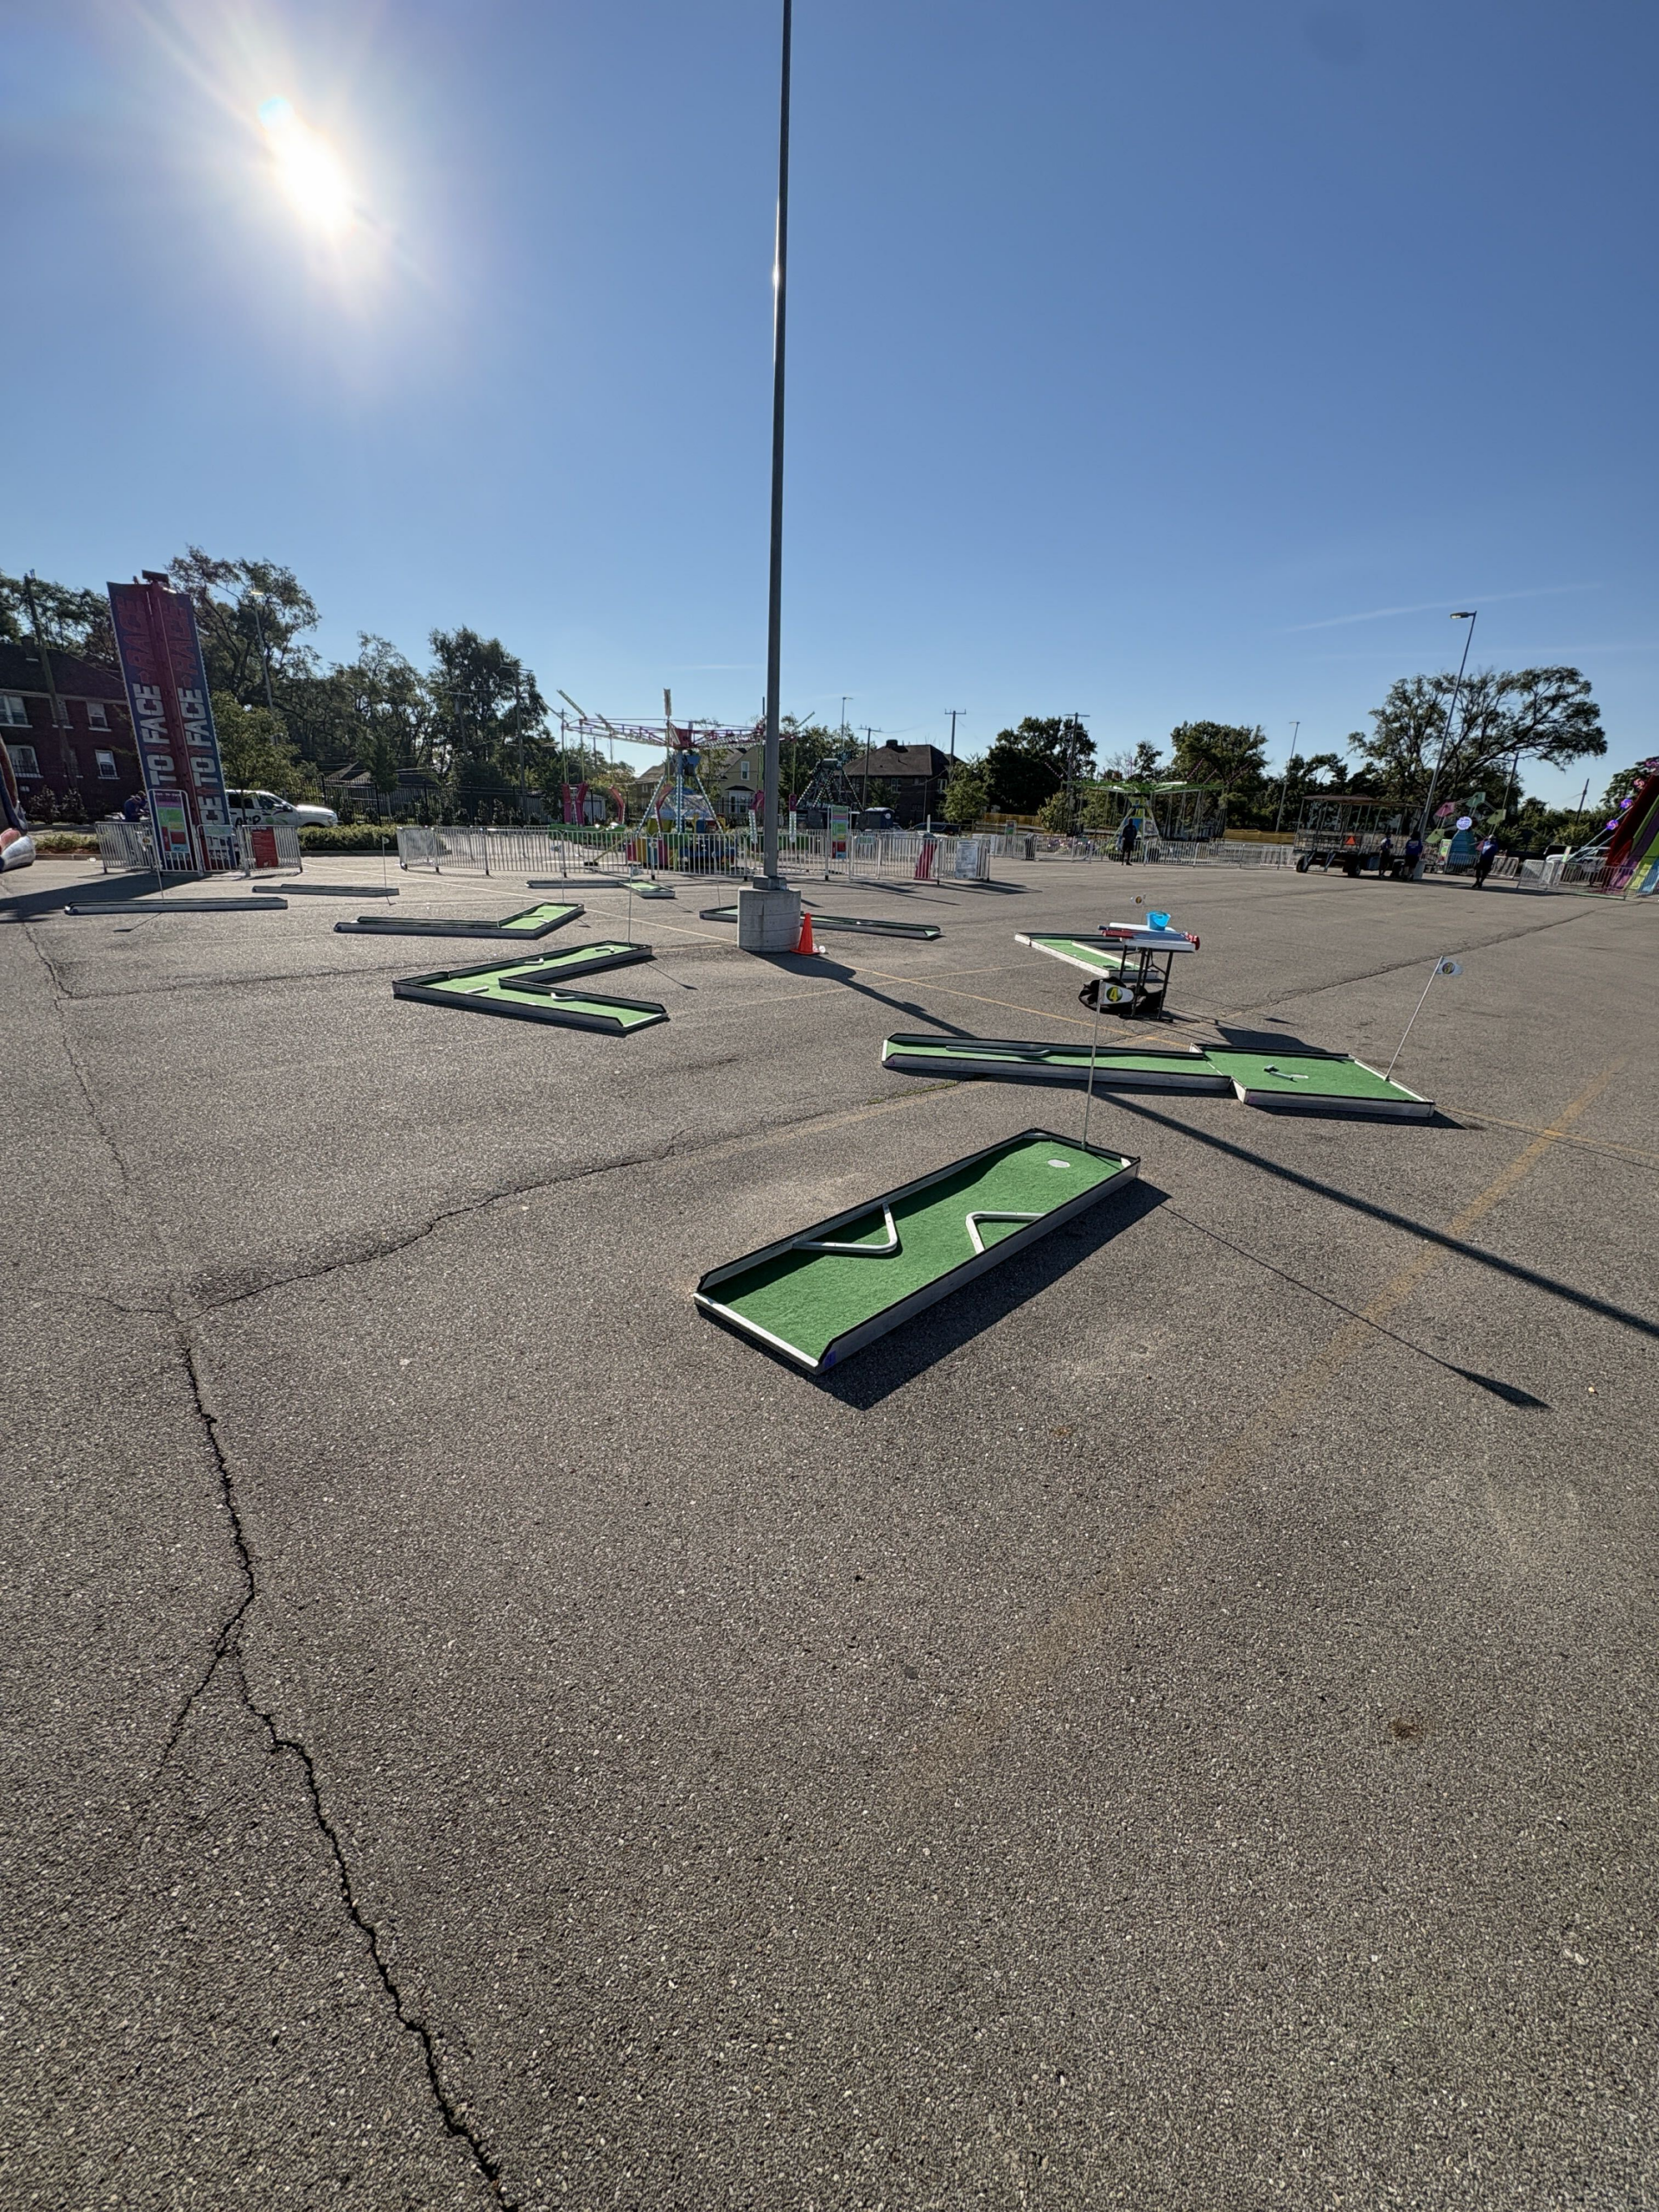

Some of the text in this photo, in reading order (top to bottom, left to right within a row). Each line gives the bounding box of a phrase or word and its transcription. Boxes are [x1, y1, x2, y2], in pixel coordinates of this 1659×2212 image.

[117, 595, 156, 671] RACE
[163, 603, 198, 676] RACE
[133, 683, 170, 744] FACE
[178, 687, 212, 747] FACE
[147, 754, 176, 785] TO
[190, 757, 219, 786] TO
[198, 797, 229, 850] FCE
[1109, 986, 1118, 1002] 4
